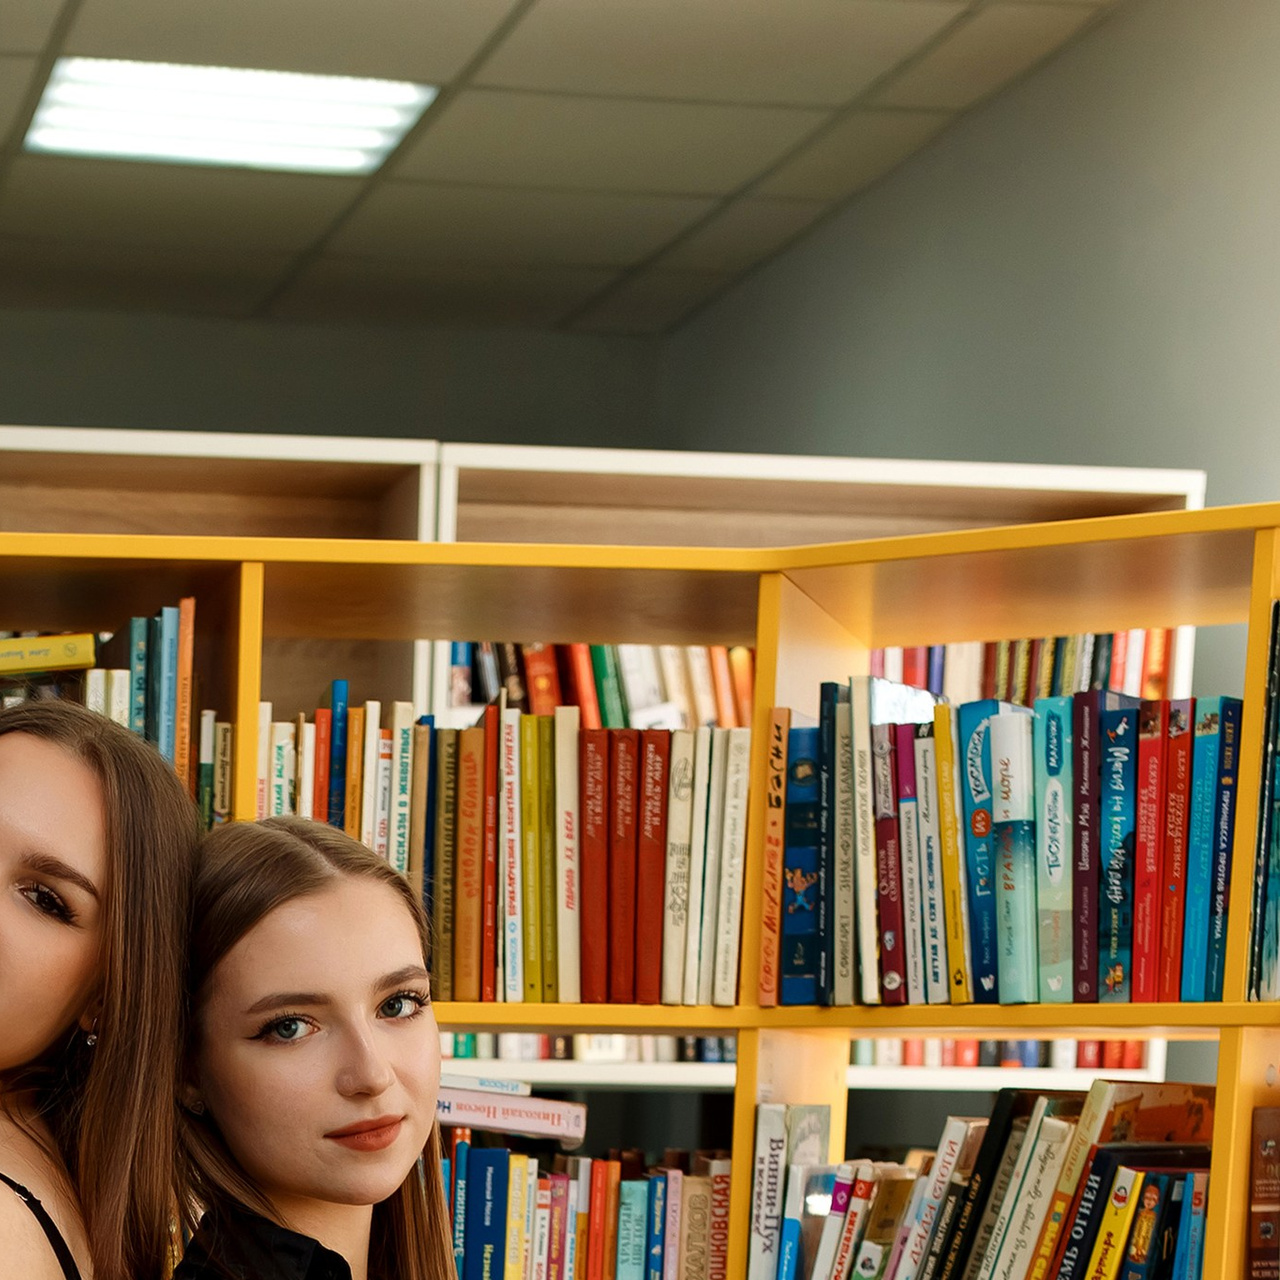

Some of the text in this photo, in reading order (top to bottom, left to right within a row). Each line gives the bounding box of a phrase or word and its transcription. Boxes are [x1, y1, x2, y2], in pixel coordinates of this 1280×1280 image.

[397, 728, 410, 870] АССКАЗЫ ЖИВОТНЫХ
[1108, 747, 1130, 791] Магия
[504, 781, 516, 833] КАПИТАНА
[1110, 796, 1126, 812] на
[505, 839, 517, 916] ПРИКЛЮЧЕНИЯ
[1214, 790, 1231, 939] ПРИНЦЕССА ПРОТИВ ВОРЧУНА
[456, 1102, 562, 1127] Николай Носов
[763, 1138, 784, 1253] Винни-Пух
[928, 1195, 958, 1253] ЭЛЕКТРОНИКА
[1071, 1173, 1102, 1239] ОГНЕЙ
